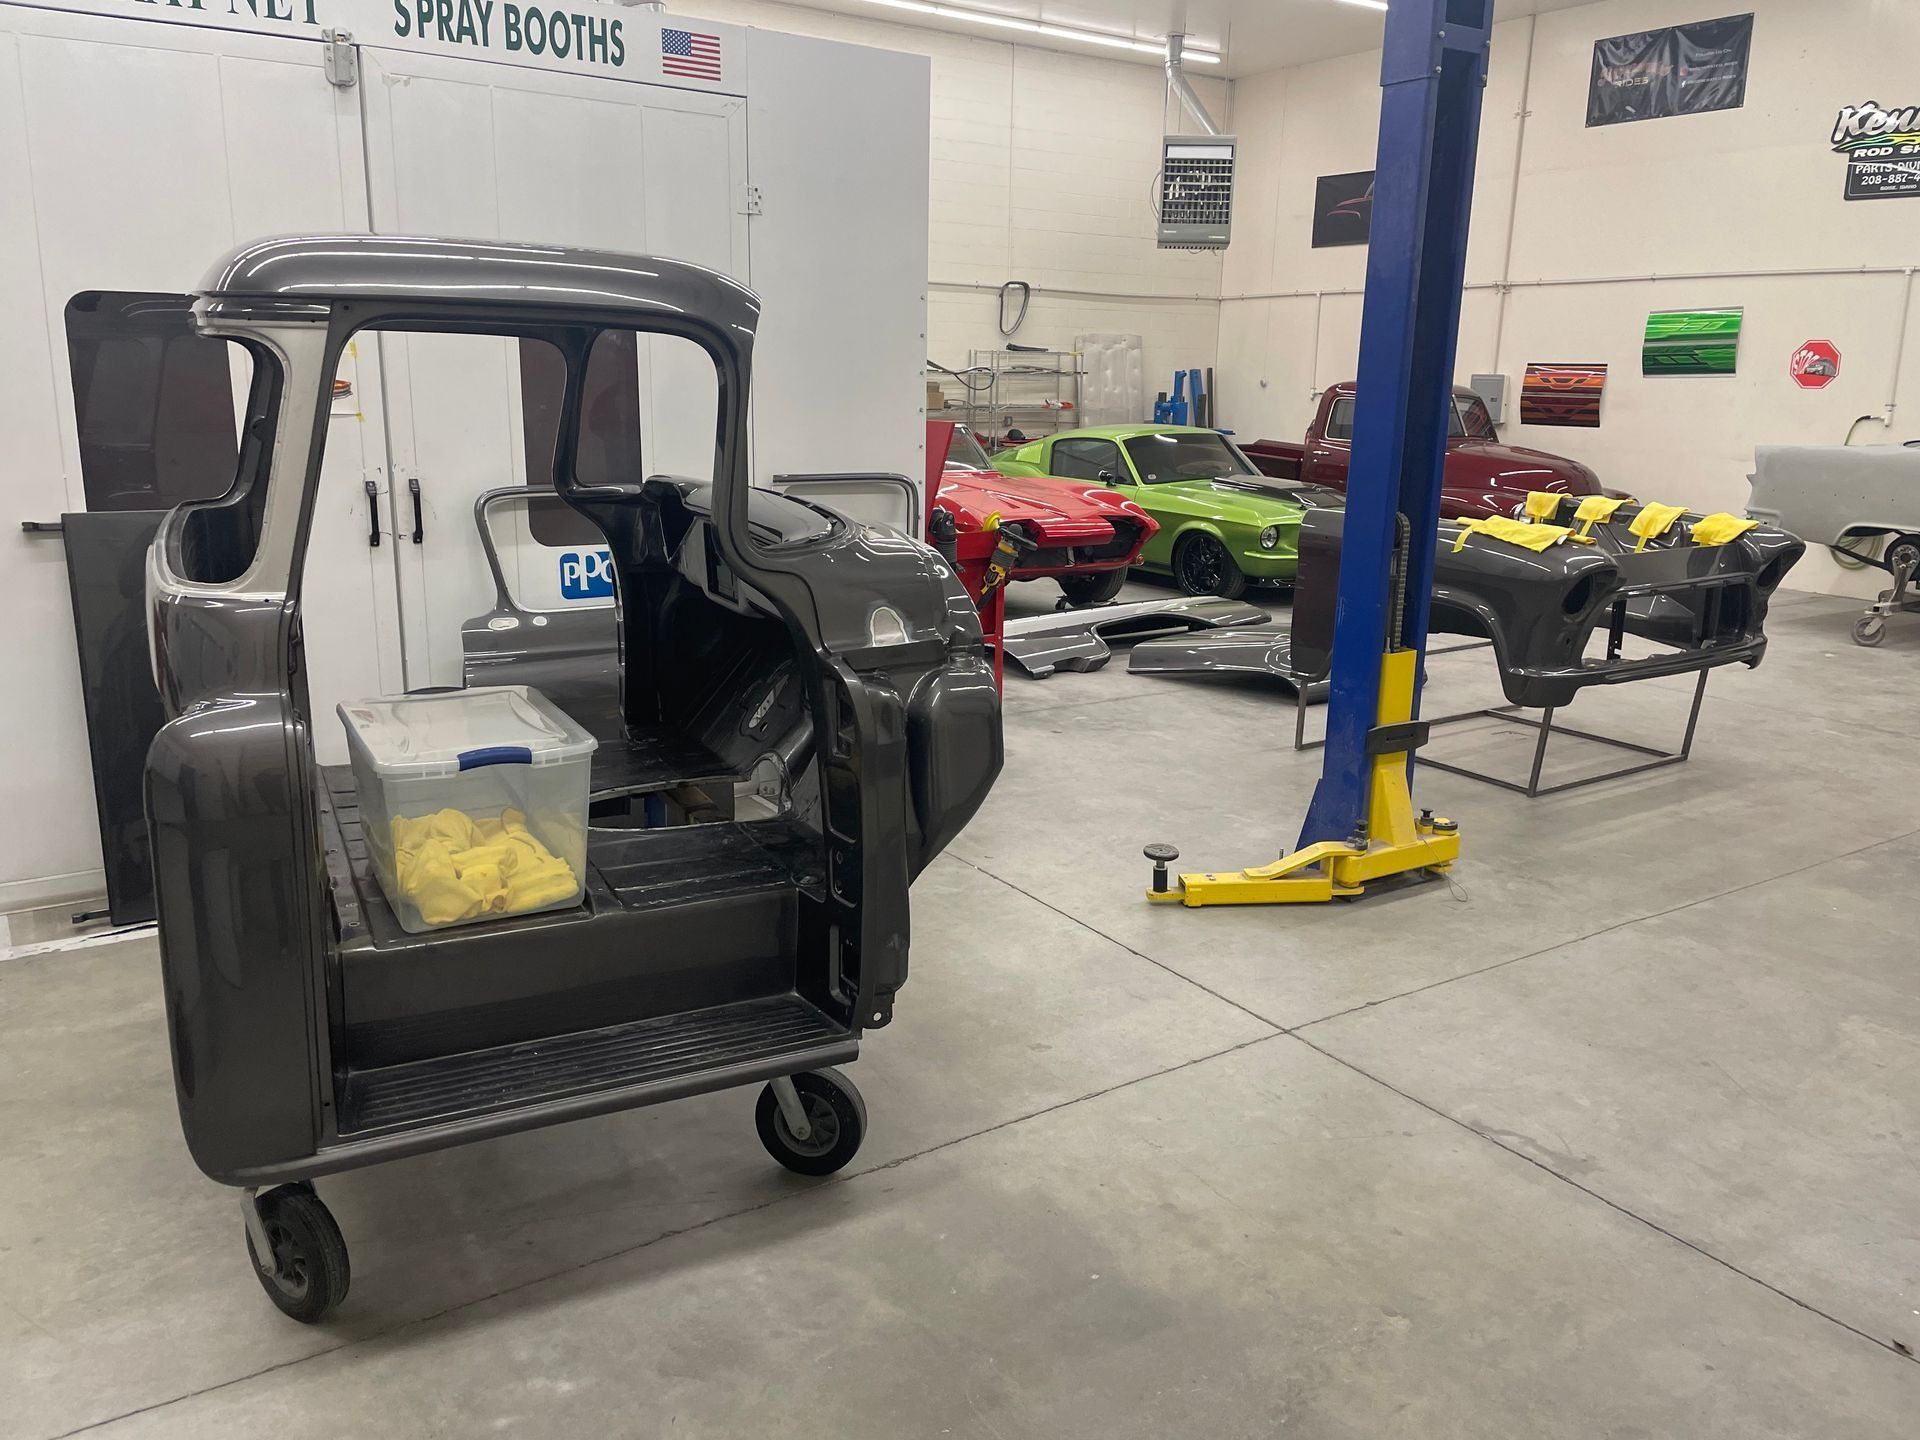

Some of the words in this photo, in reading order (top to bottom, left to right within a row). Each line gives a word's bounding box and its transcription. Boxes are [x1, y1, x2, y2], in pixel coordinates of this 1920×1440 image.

[394, 0, 493, 48] SPRAY
[504, 3, 625, 66] BOOTHS
[1853, 147, 1894, 158] ROD
[1855, 162, 1893, 174] PARTS
